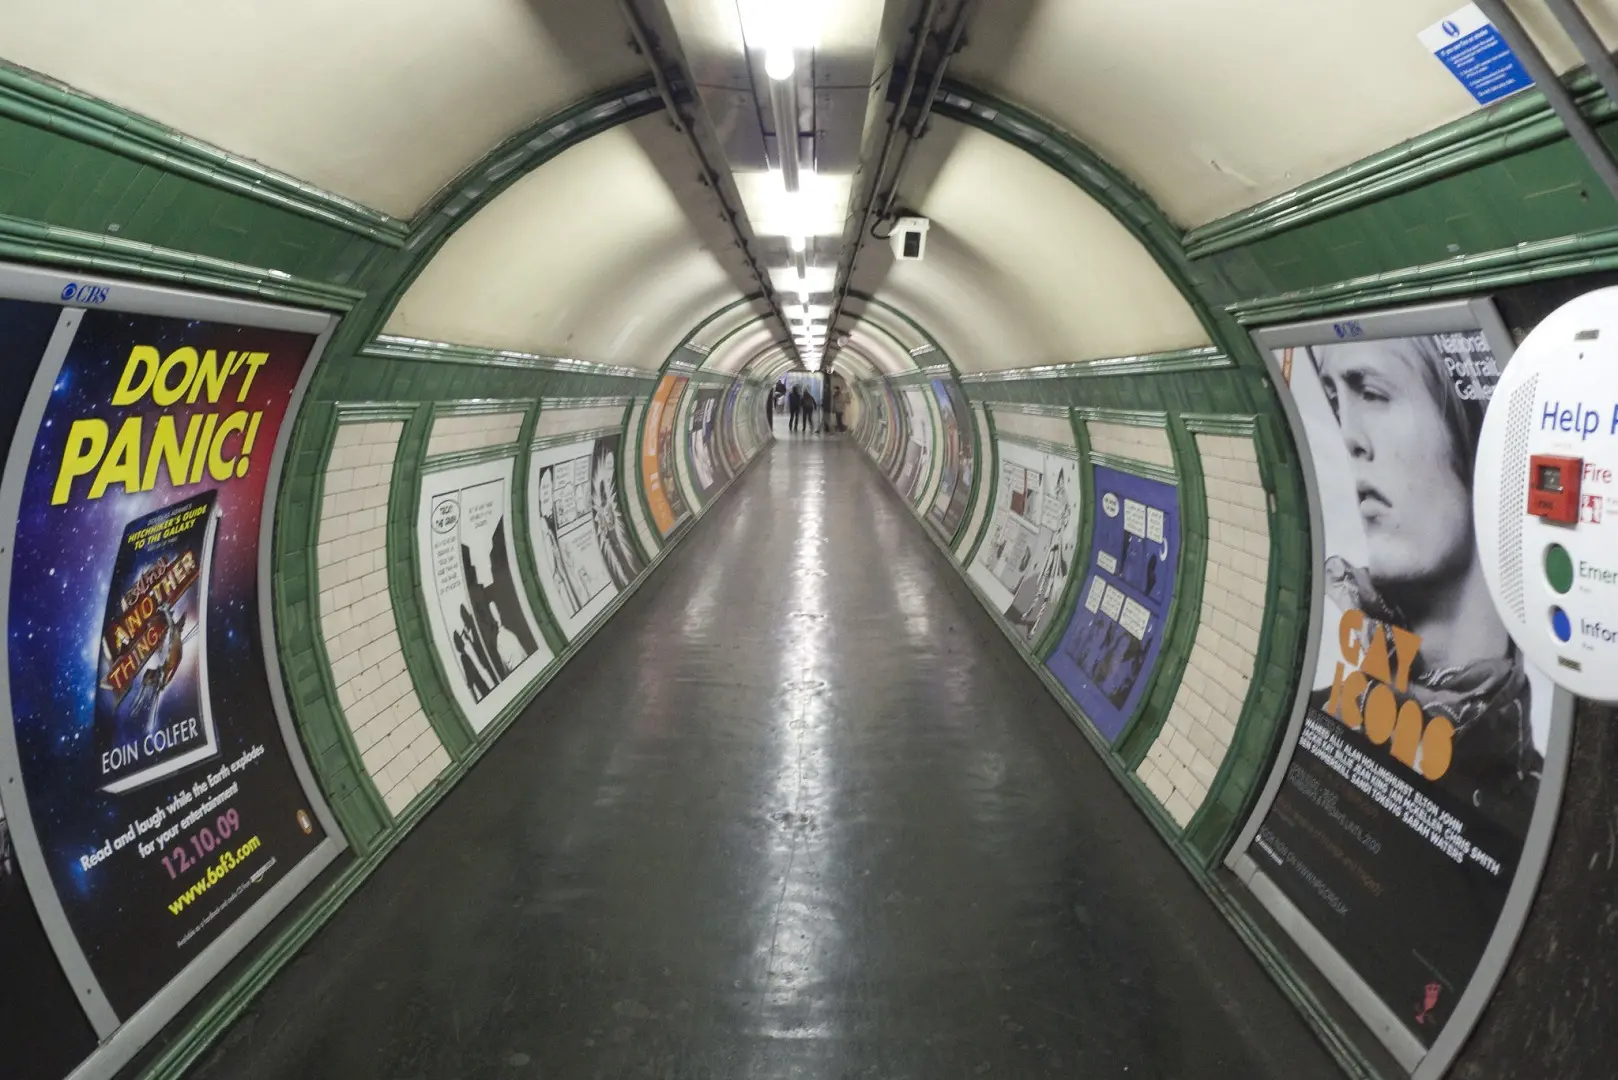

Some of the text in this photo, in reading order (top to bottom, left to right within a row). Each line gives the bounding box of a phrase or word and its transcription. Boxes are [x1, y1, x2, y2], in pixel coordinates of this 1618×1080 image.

[75, 284, 109, 304] CBS
[112, 345, 270, 406] DON'T
[1445, 356, 1501, 377] Portrait
[1541, 401, 1599, 441] Help
[51, 410, 263, 506] PANIC!
[1583, 463, 1612, 483] Fire
[128, 504, 208, 543] HITCHHIKER'S GUIDE
[134, 539, 145, 551] TO
[148, 531, 162, 545] THE
[163, 519, 196, 538] GALAXY
[114, 551, 196, 649] ANOTHER
[1339, 609, 1423, 693] GAY
[102, 717, 199, 774] EOIN COLFER
[80, 743, 265, 872] Read and laugh while the Earth explodes
[138, 781, 239, 859] for your entertainment
[1414, 791, 1439, 817] ELTON
[1438, 810, 1463, 834] JOHN
[161, 808, 241, 880] 12.10.09
[1402, 811, 1431, 838] SARAH
[1430, 831, 1464, 864] WATERS
[1444, 827, 1471, 854] CHRIS
[1470, 846, 1501, 875] SMITH
[168, 835, 262, 916] www.6of3.com
